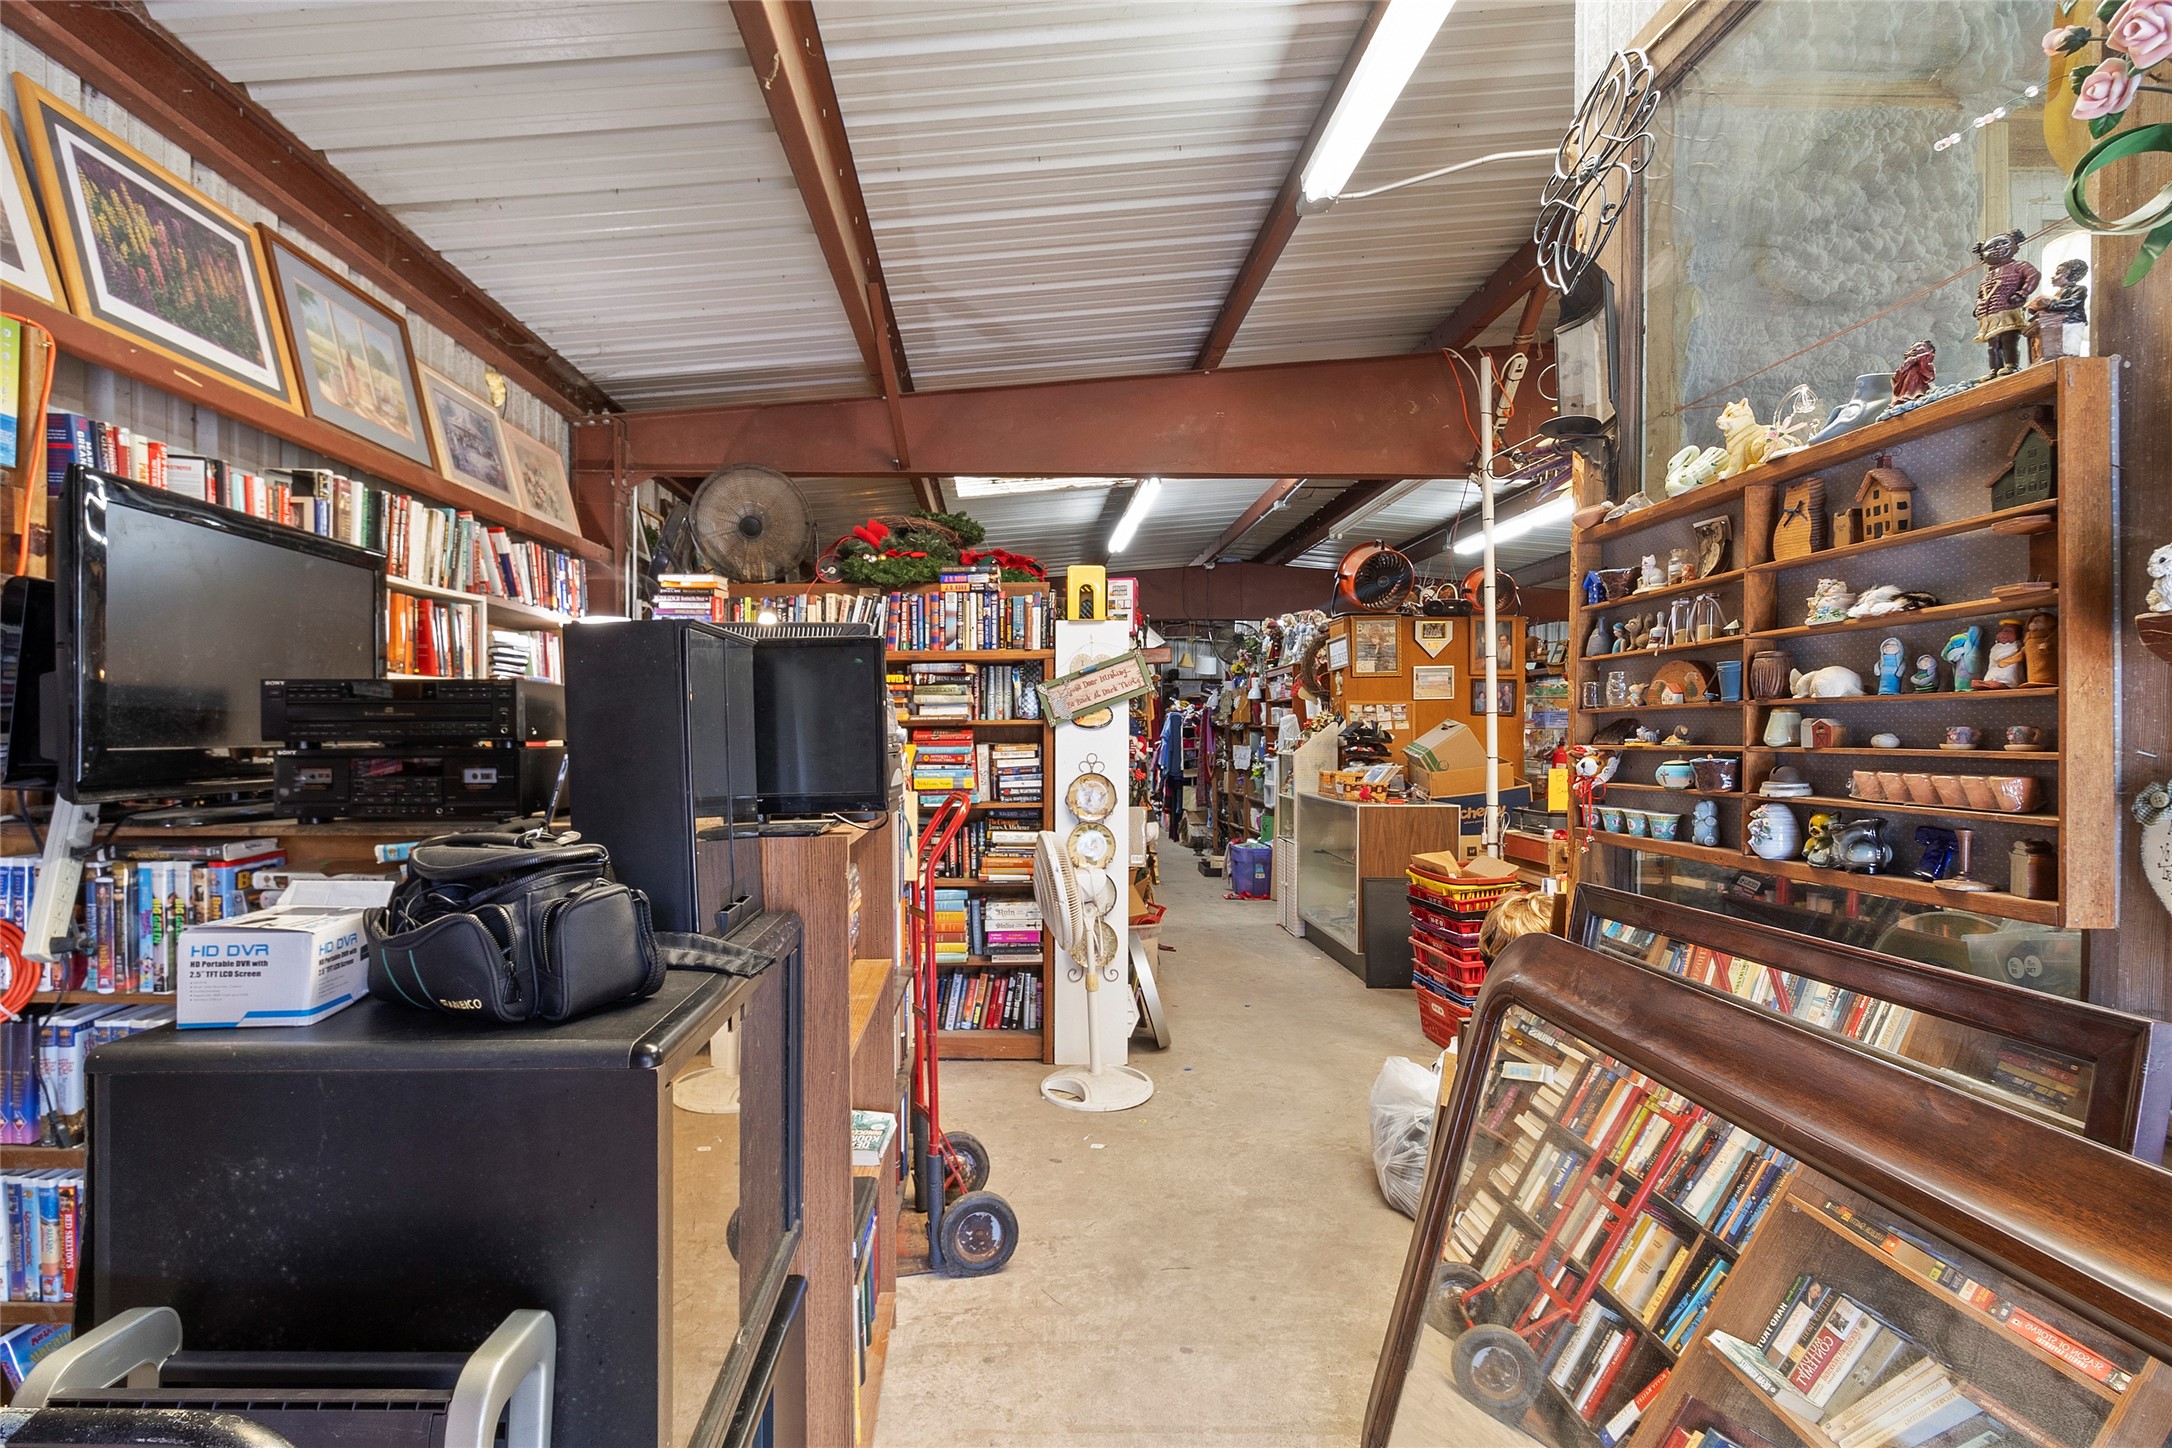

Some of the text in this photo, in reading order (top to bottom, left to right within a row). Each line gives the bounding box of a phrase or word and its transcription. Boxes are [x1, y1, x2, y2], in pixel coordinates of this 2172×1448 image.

[1461, 805, 1507, 821] chey
[152, 898, 162, 914] BIG
[191, 944, 270, 957] HD DVR
[319, 933, 358, 957] HD DVR
[201, 960, 234, 968] Portable
[64, 1213, 74, 1269] RED SKELTON'S
